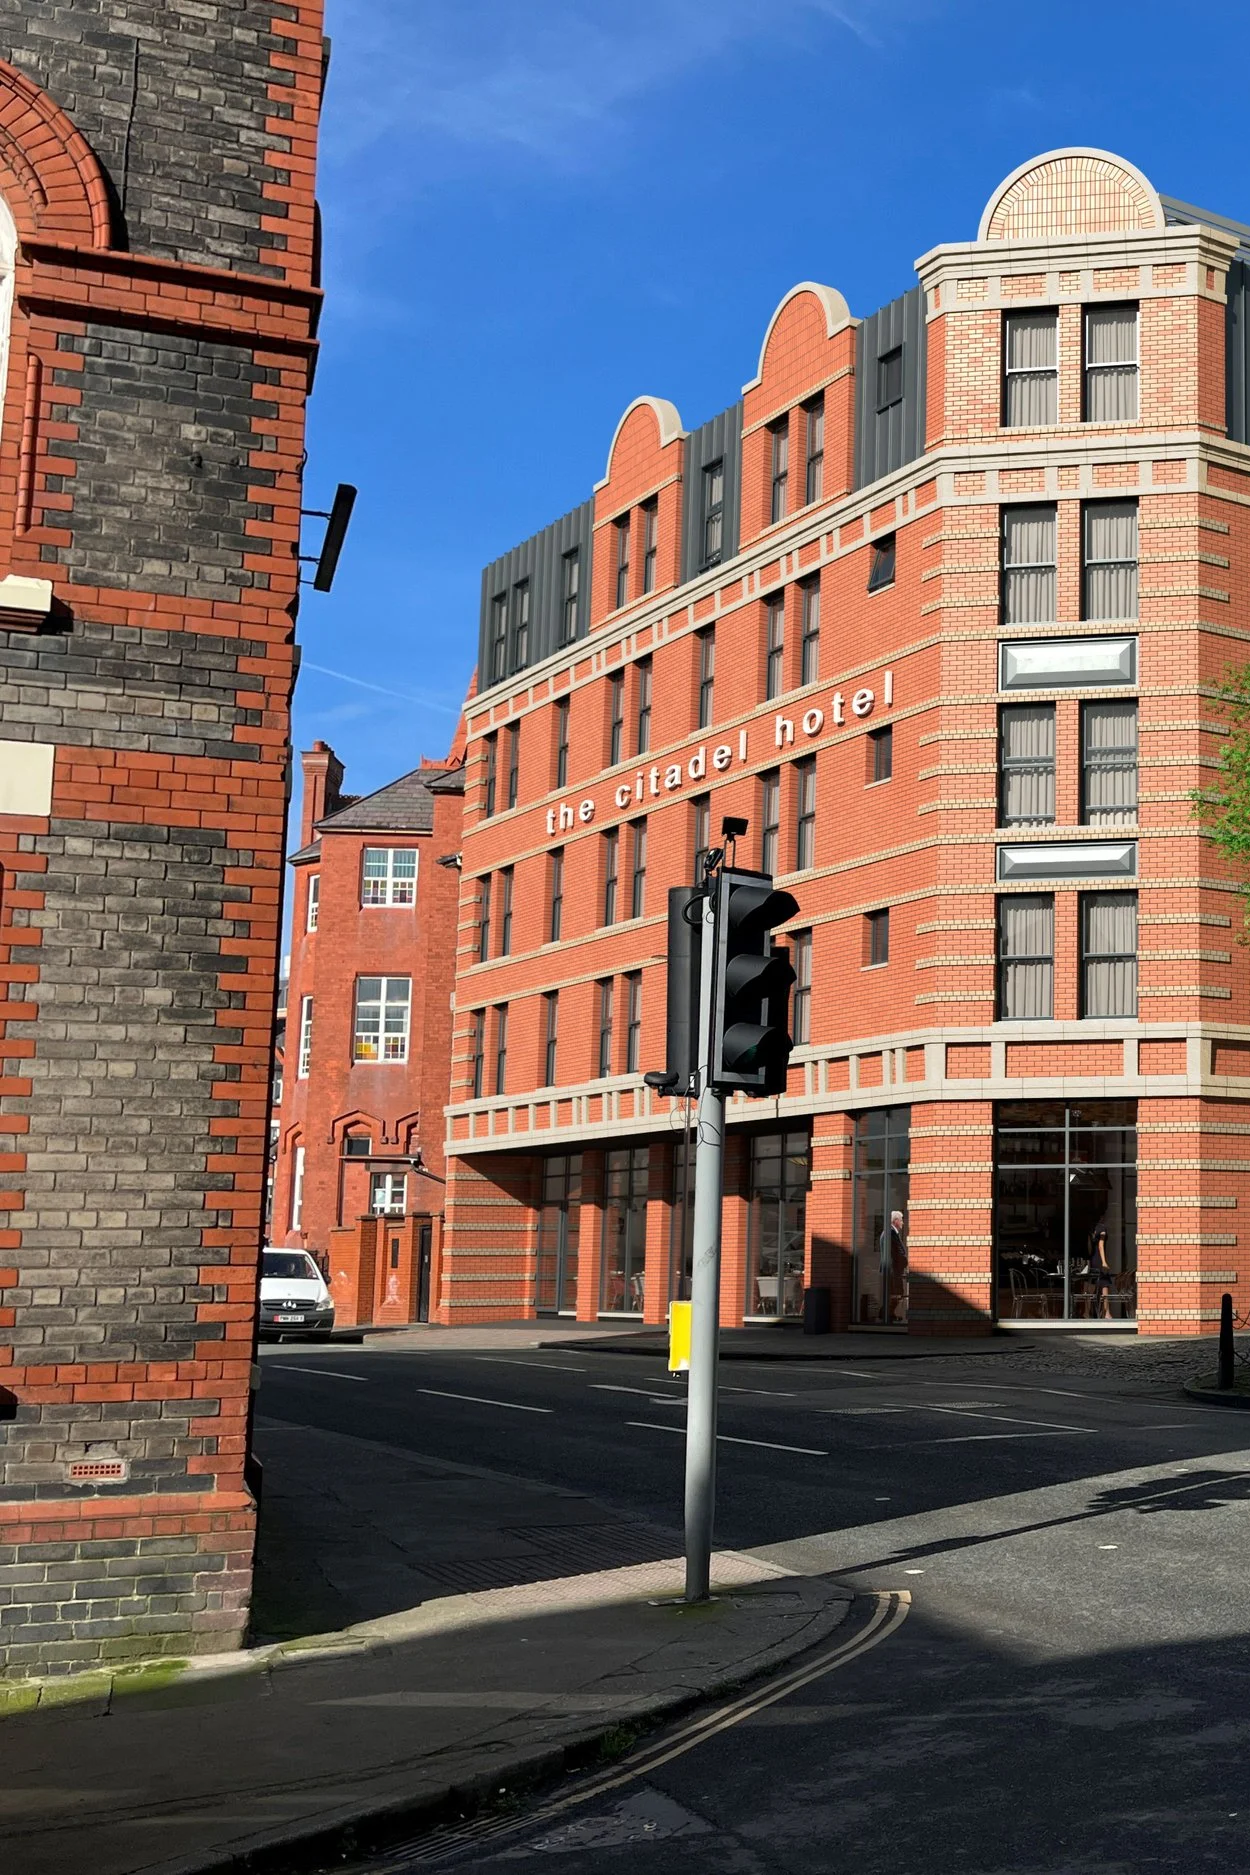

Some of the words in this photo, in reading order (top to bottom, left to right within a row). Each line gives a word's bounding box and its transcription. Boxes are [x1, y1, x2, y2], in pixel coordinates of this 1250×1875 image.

[546, 799, 595, 834] the
[615, 730, 748, 808] citadel
[775, 670, 893, 747] hotel
